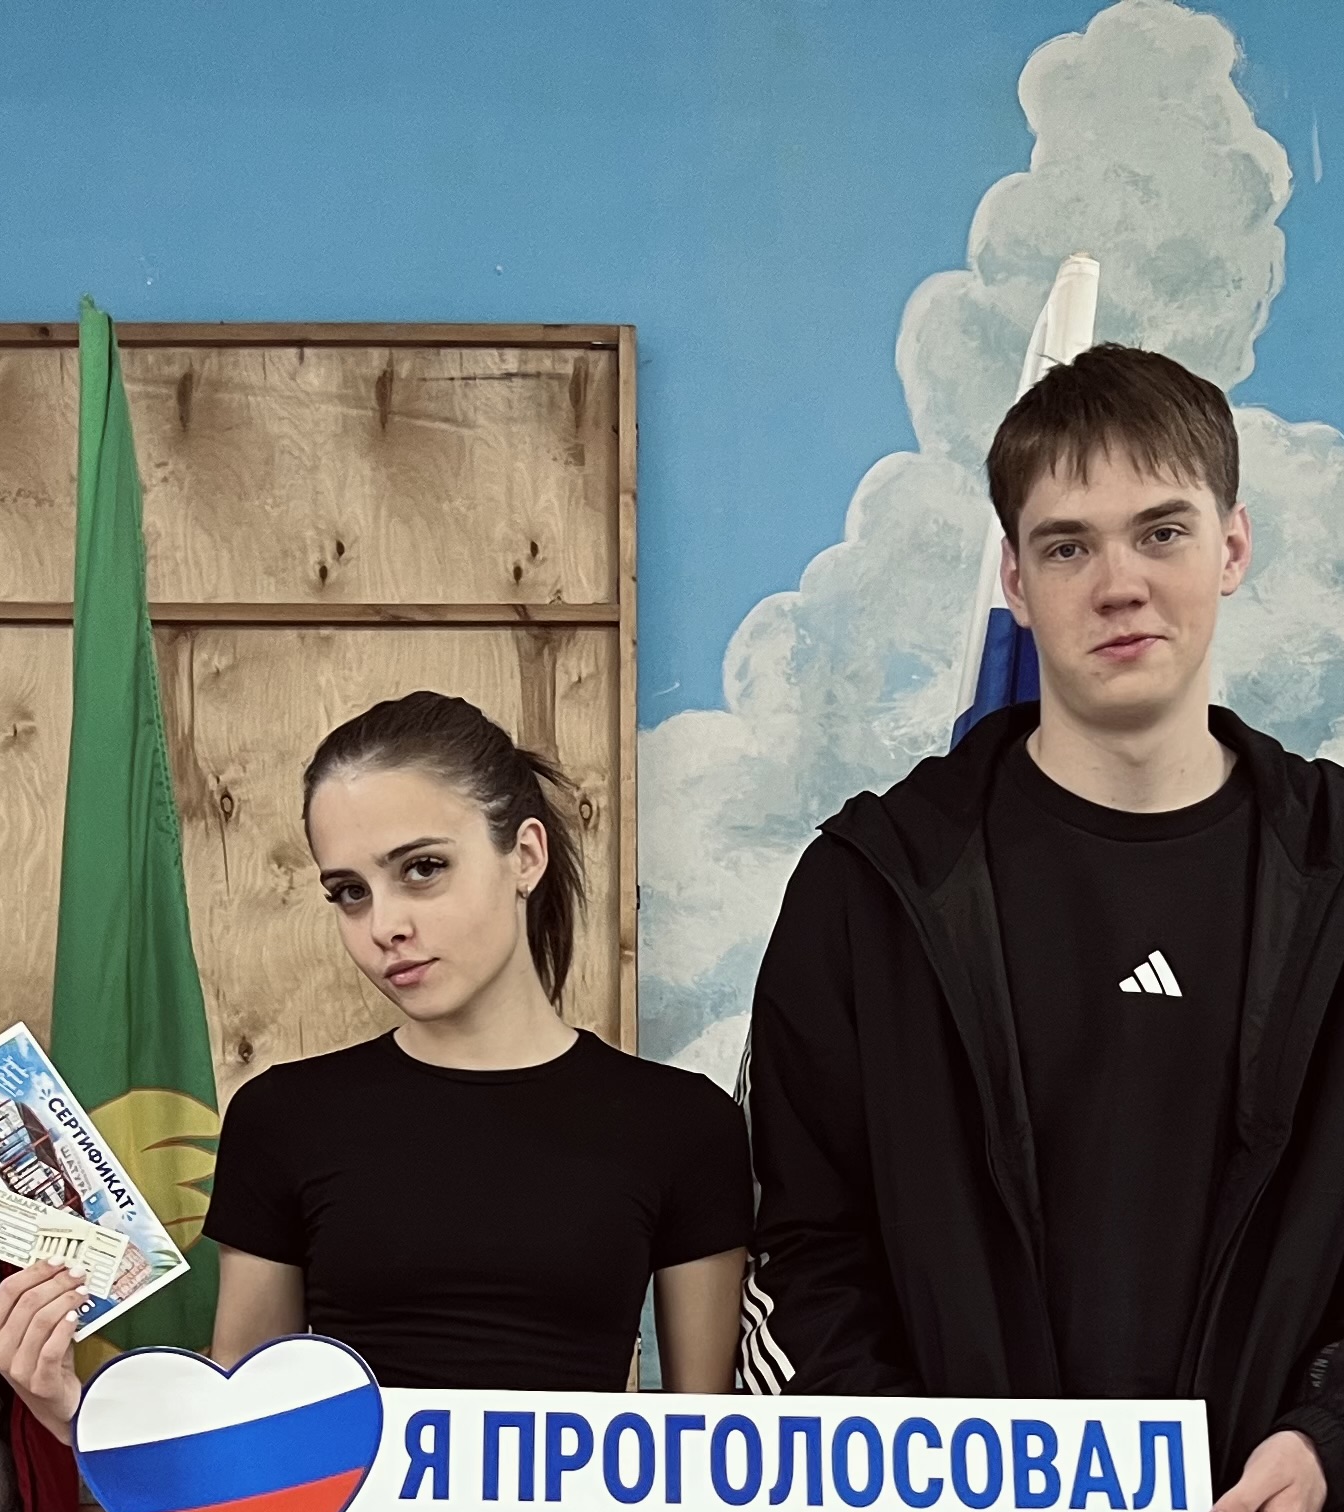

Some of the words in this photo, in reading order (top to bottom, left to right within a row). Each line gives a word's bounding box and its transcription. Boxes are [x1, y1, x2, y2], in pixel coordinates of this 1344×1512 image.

[48, 1097, 134, 1210] СЕРТИФИКАТ
[61, 1145, 87, 1196] ШАТУРА
[399, 1410, 450, 1500] Я
[482, 1410, 1187, 1511] ПРОГОЛОСОВАЛ
